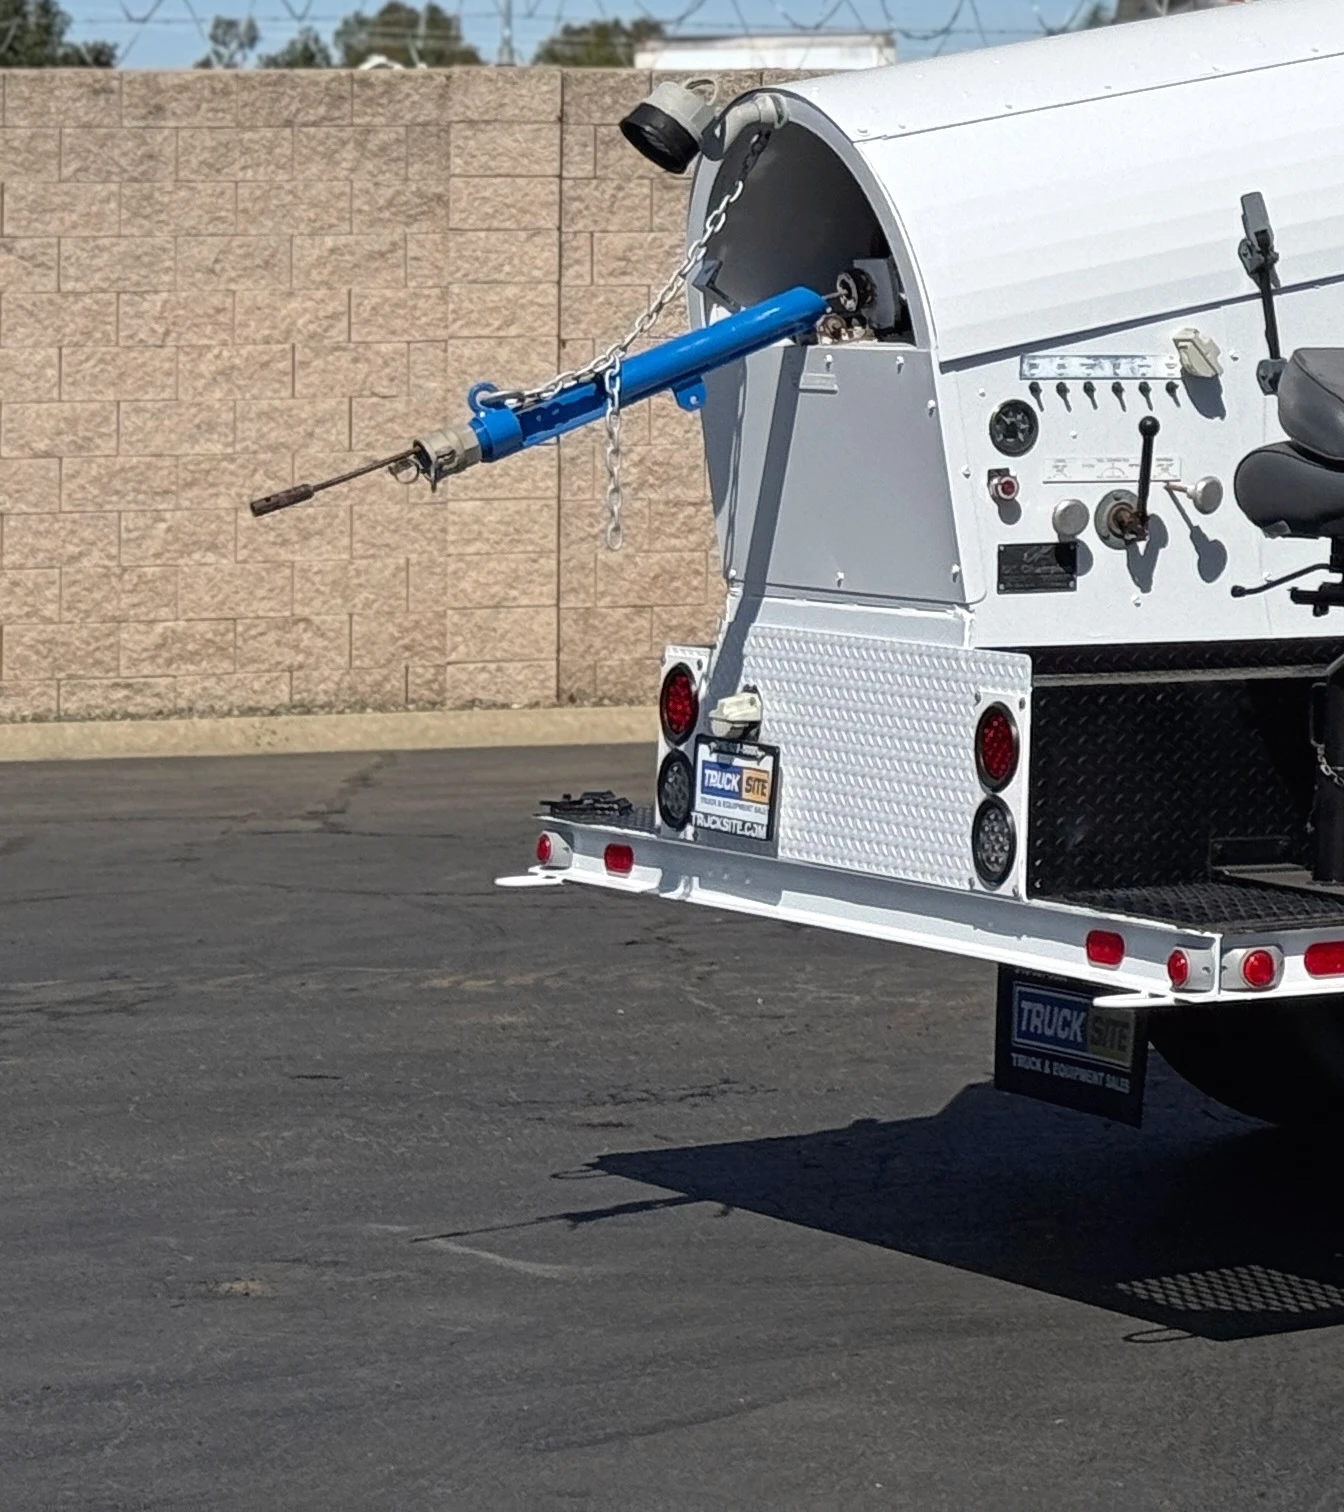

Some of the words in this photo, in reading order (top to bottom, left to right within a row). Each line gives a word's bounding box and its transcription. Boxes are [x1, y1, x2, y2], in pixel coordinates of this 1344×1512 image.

[703, 768, 741, 792] TRUCK
[744, 776, 769, 798] SITE
[691, 811, 768, 840] TRUCKSITE.COM
[1020, 999, 1087, 1043] TRUCK
[1091, 1014, 1130, 1052] SITE
[1010, 1051, 1042, 1072] TRUCK
[1052, 1061, 1105, 1086] EQUIPMENT
